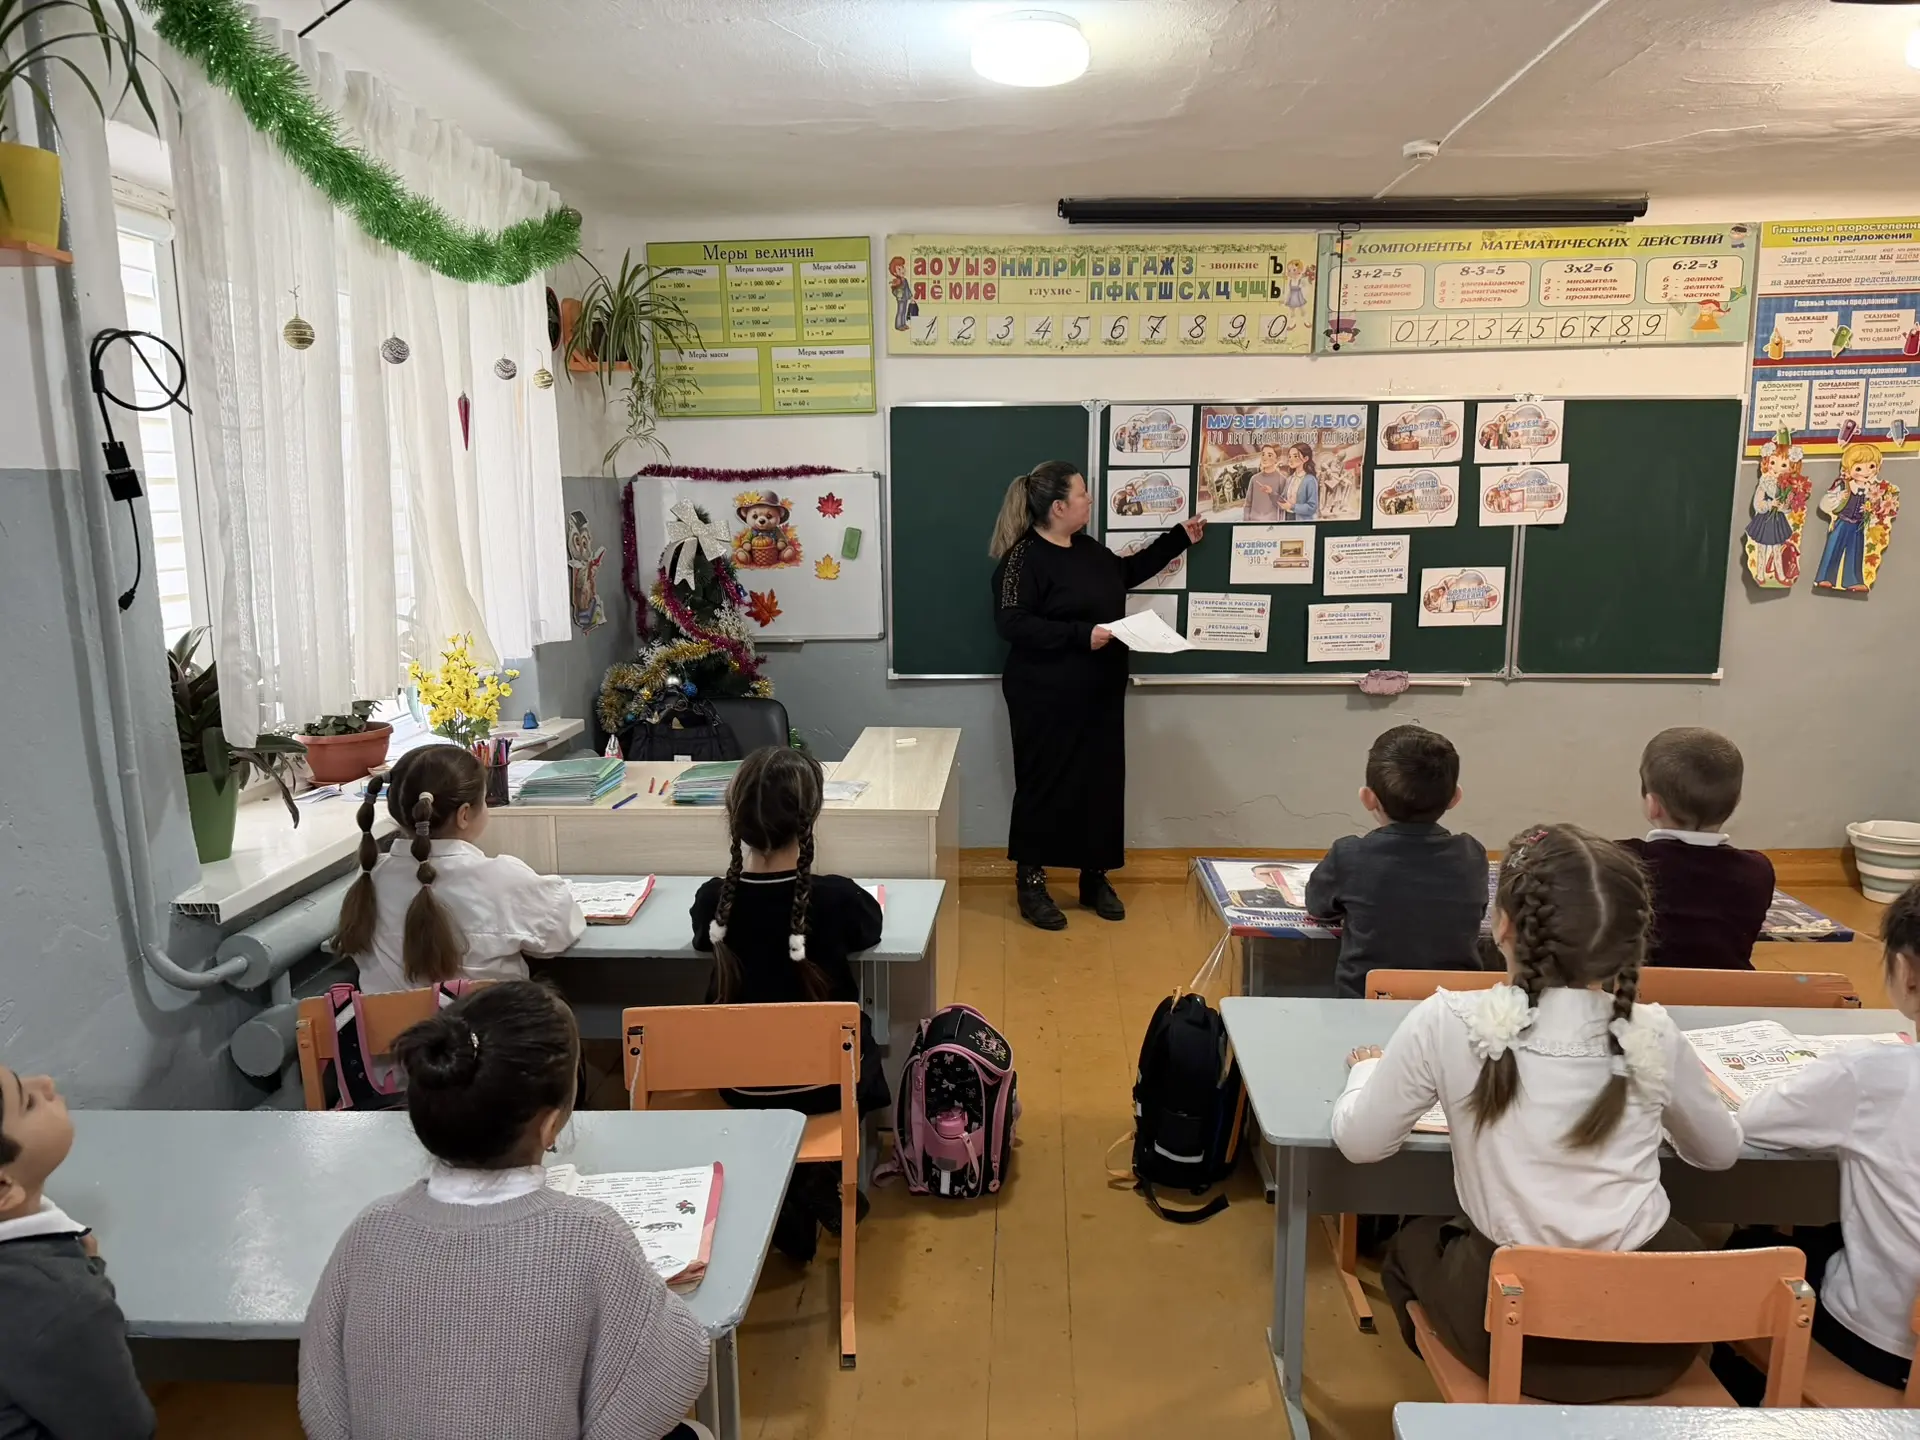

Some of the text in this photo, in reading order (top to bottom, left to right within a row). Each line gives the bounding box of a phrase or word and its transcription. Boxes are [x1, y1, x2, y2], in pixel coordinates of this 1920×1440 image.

[1773, 225, 1822, 235] Главные
[1792, 232, 1912, 243] члены предложения
[1357, 233, 1724, 254] КОМПОНЕНТЫ МАТЕМАТИЧЕСКИХ ДЕЙСТВИЙ
[704, 244, 814, 262] Меры величин
[1781, 255, 1812, 264] Завтра
[1822, 254, 1876, 264] родителями
[1460, 265, 1506, 276] 8-3=5
[1672, 259, 1718, 271] 6:2=3
[1352, 268, 1403, 279] 3+2=5
[1784, 277, 1852, 285] замечательное
[1029, 288, 1072, 298] глухие
[926, 314, 1288, 340] 1 2 3 4 5 6 7 8 9 0
[1395, 314, 1661, 342] 0 1 2 3 4 5 6 7 8 9
[1872, 335, 1902, 343] сделает?
[1207, 412, 1361, 429] МУЗЕЙНОЕ ДЕЛО
[1208, 431, 1223, 445] 170
[1236, 541, 1277, 549] МУЗЕЙНОЕ
[1746, 1054, 1764, 1063] 31
